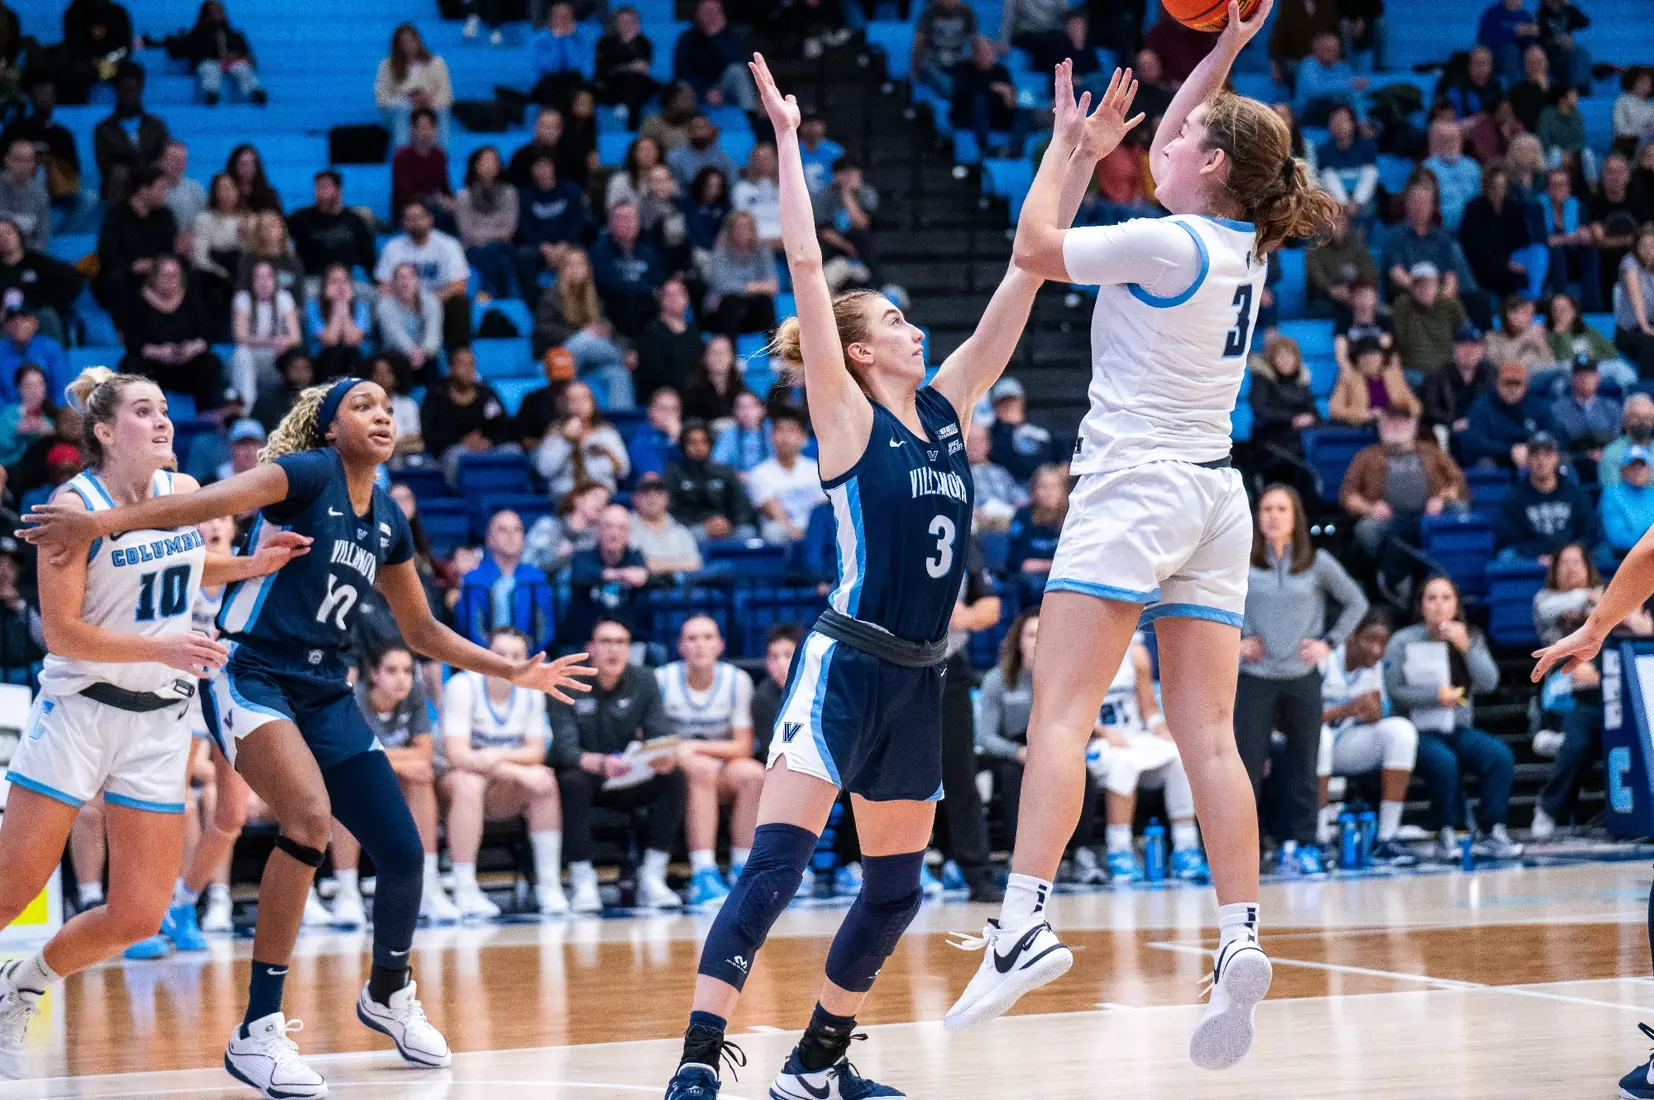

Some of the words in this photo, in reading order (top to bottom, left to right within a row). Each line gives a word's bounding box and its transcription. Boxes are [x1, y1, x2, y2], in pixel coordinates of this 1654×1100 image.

[1222, 283, 1254, 359] 3
[925, 514, 956, 579] 3
[135, 562, 193, 622] 10
[782, 721, 804, 743] V
[1608, 746, 1634, 814] C
